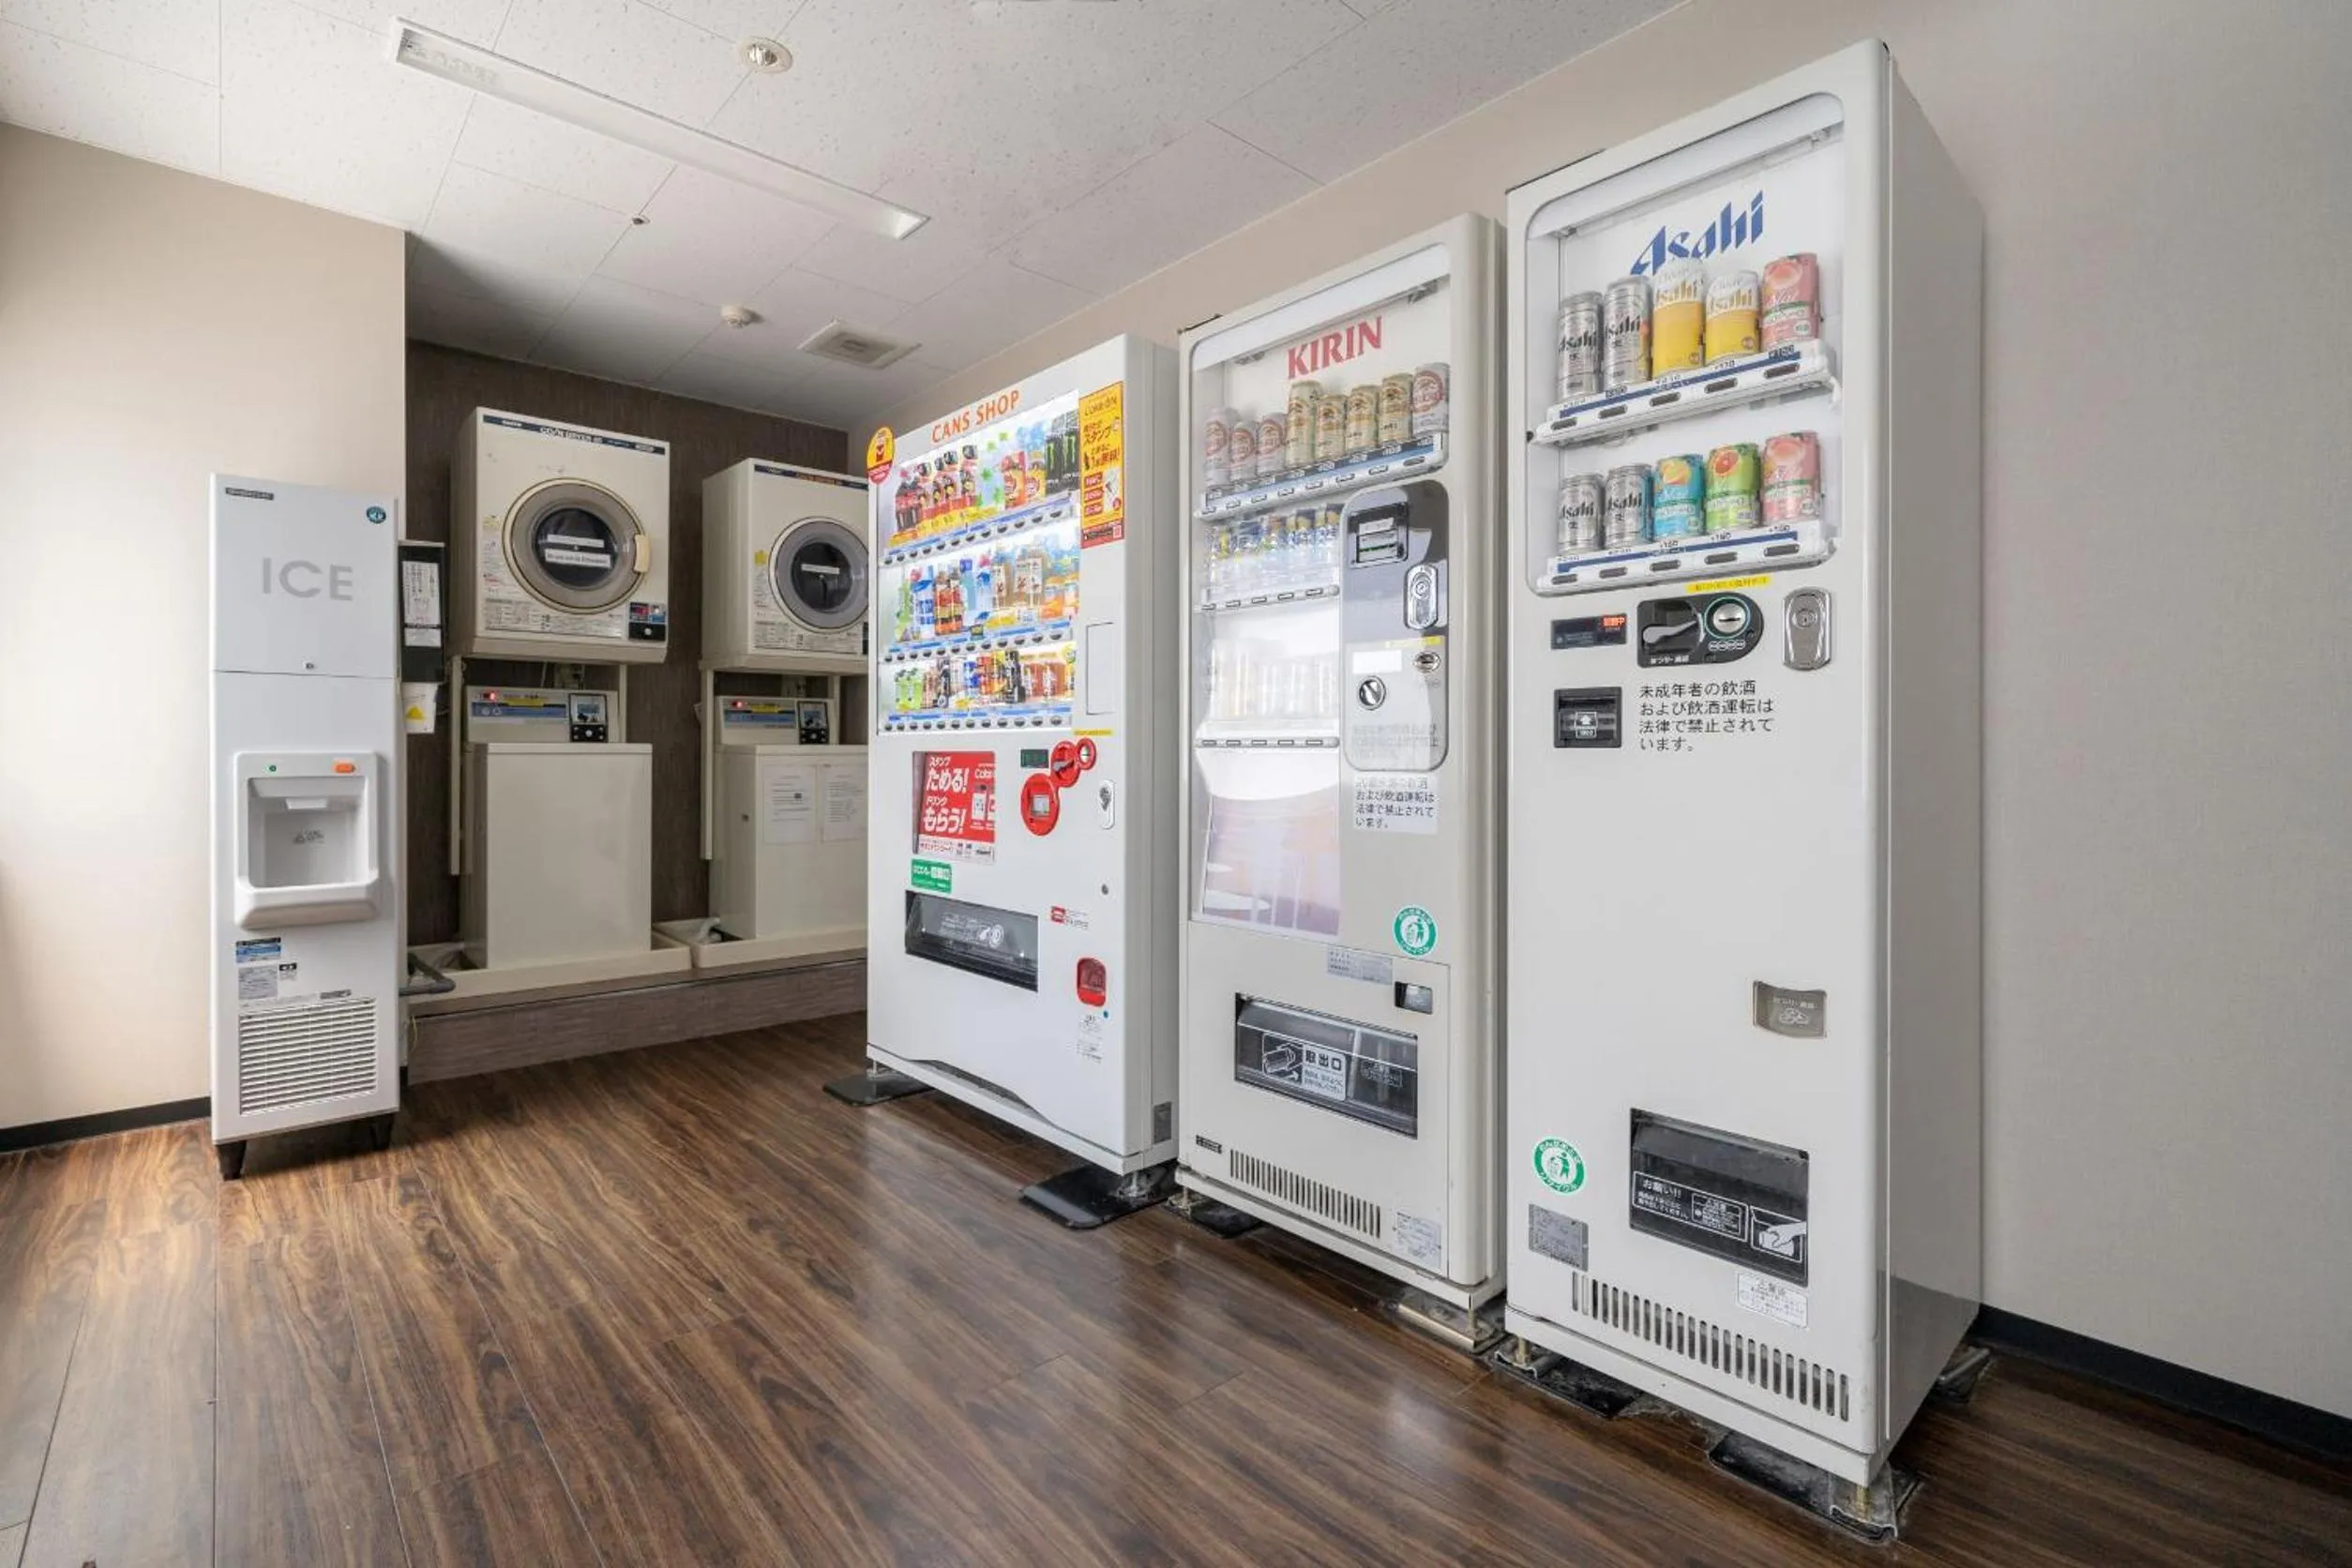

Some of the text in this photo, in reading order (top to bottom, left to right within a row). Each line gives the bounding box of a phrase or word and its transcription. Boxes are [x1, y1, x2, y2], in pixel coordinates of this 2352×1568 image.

[1630, 189, 1763, 276] Asahi
[1288, 314, 1383, 380] KIRIN
[930, 389, 1021, 444] CANS SHOP
[262, 557, 354, 601] ICE
[1639, 680, 1756, 699] 未成年者の飲酒
[1640, 699, 1774, 716] および飲酒運転は
[1639, 717, 1775, 734] 法律で禁止されて
[1640, 736, 1695, 751] います。
[1305, 1049, 1342, 1071] 取出口
